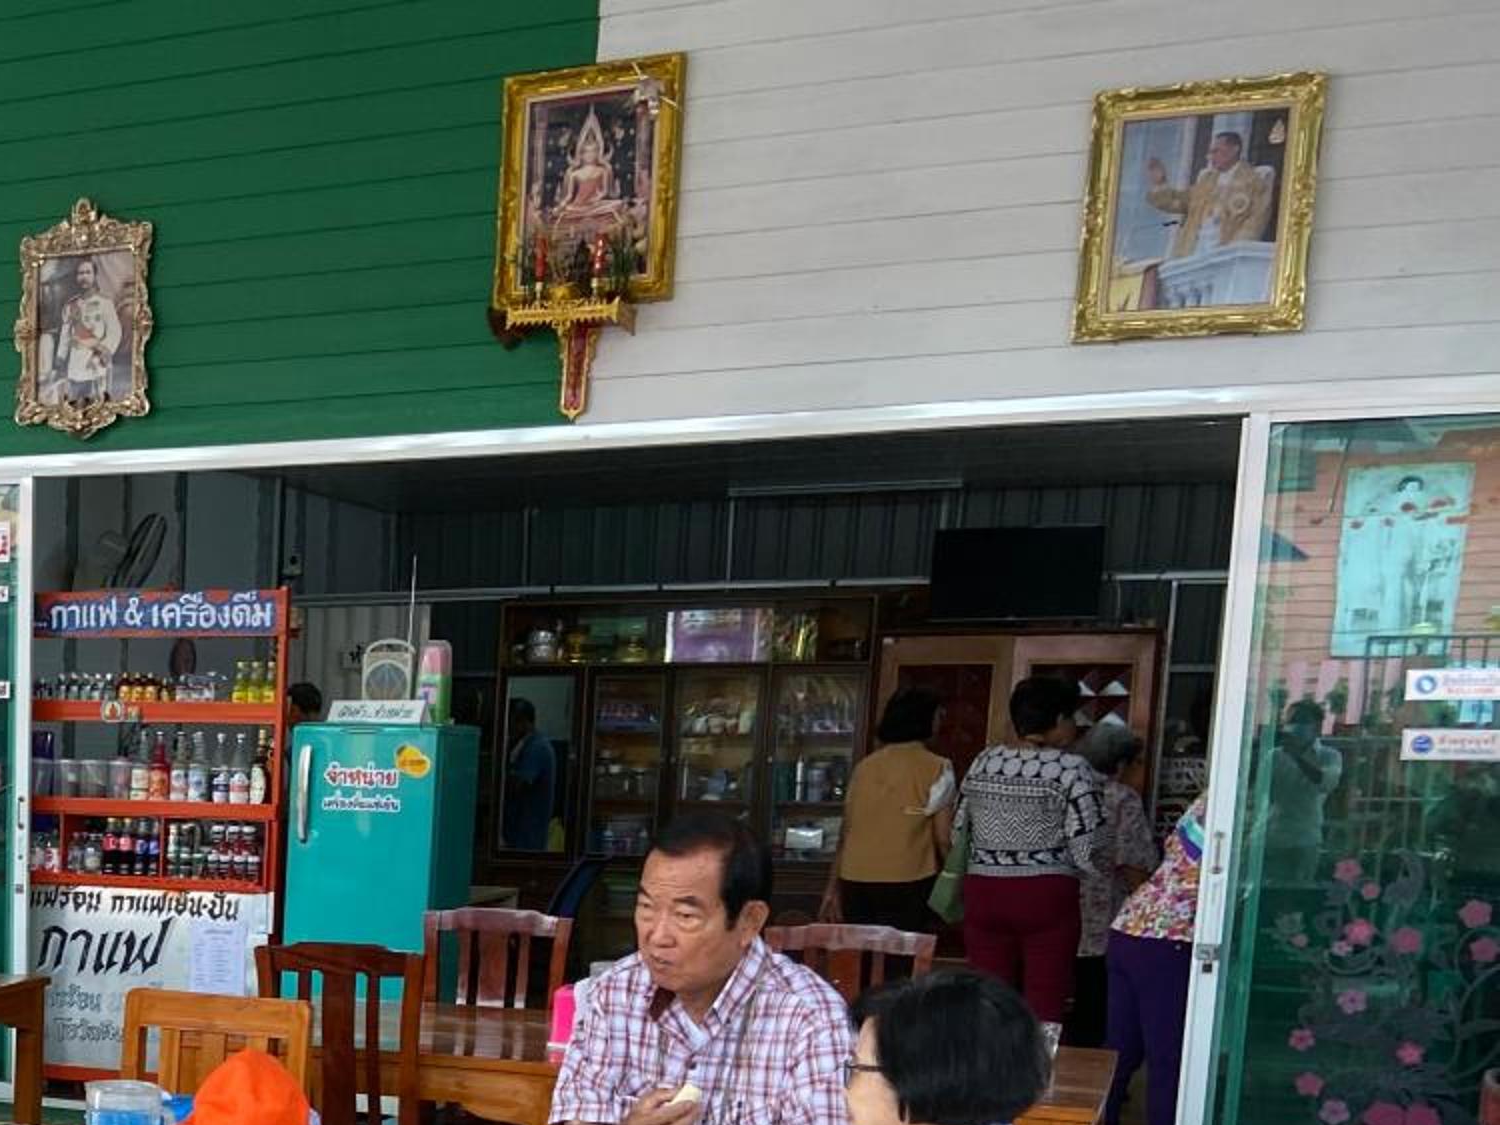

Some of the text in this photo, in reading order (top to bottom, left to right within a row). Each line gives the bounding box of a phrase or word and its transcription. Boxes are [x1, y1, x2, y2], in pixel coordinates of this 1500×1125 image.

[50, 590, 273, 630] กาแฟ & เครื่องดื่ม
[38, 916, 175, 976] กาแฟ
